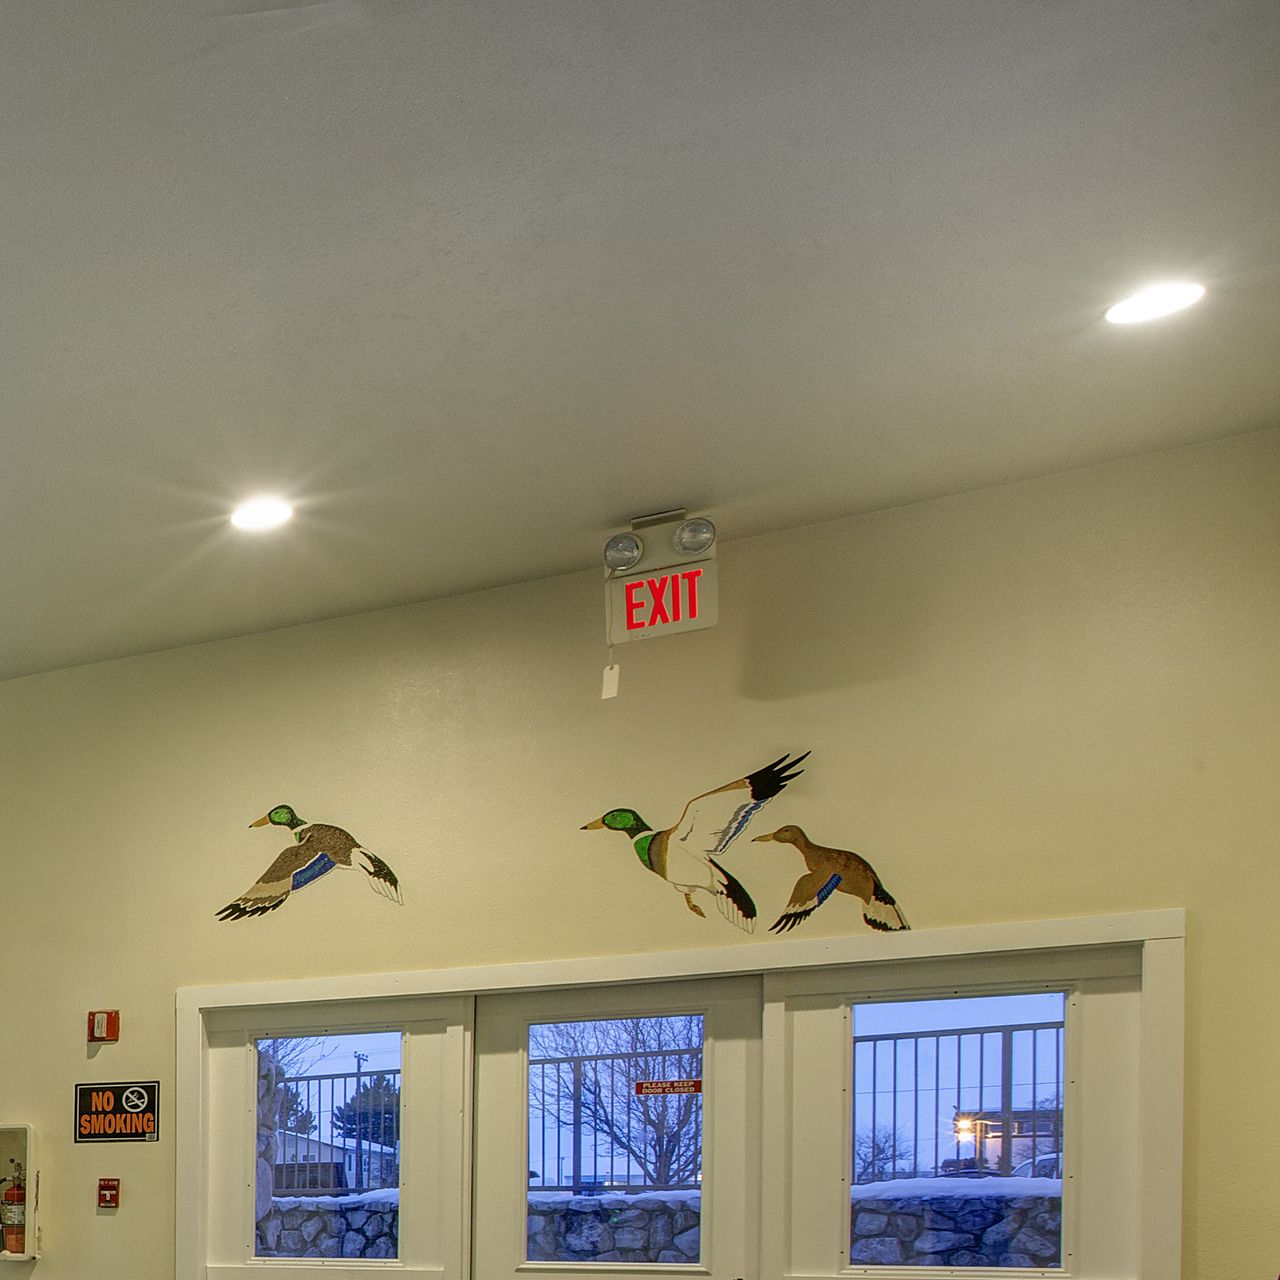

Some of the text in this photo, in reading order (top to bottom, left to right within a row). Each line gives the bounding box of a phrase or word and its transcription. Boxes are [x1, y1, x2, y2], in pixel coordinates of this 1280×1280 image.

[625, 568, 703, 630] EXIT
[92, 1091, 114, 1112] NO
[80, 1112, 155, 1135] SMOKING
